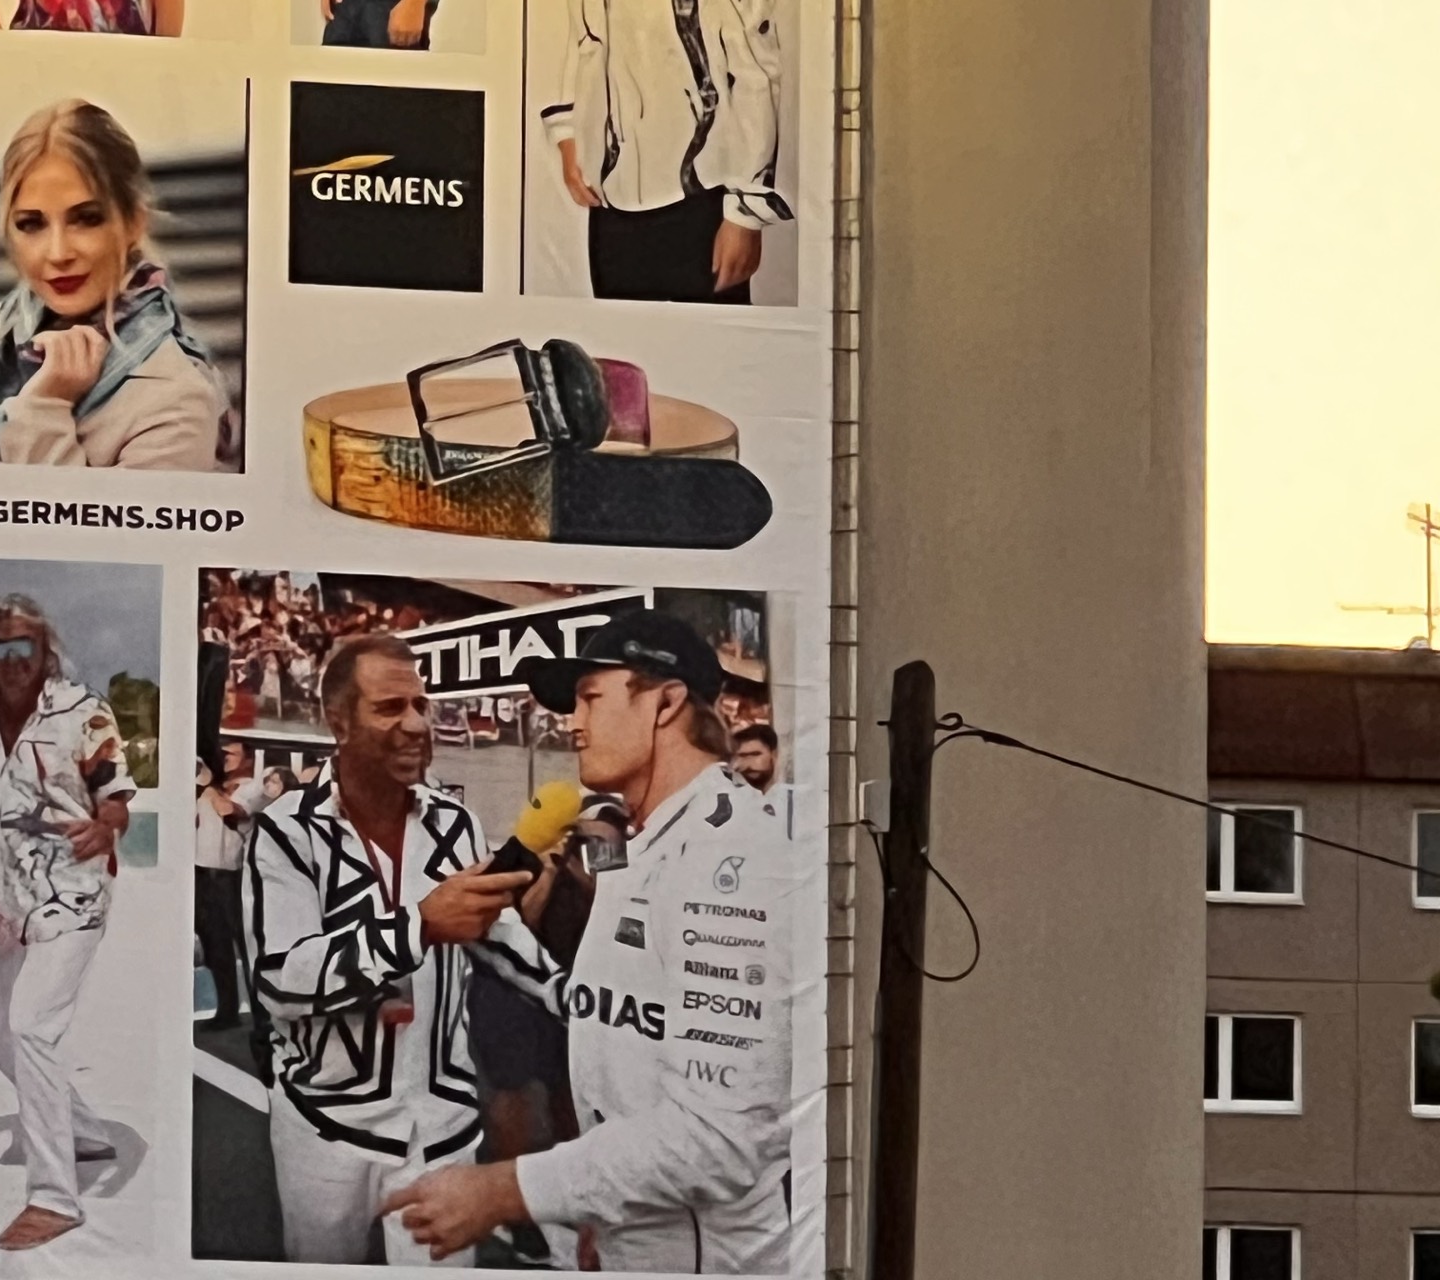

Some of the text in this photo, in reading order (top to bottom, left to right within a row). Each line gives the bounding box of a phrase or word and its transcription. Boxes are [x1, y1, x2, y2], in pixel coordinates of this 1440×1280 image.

[311, 173, 464, 207] GERMENS
[683, 990, 761, 1020] EPSON
[685, 1059, 738, 1088] IWC
